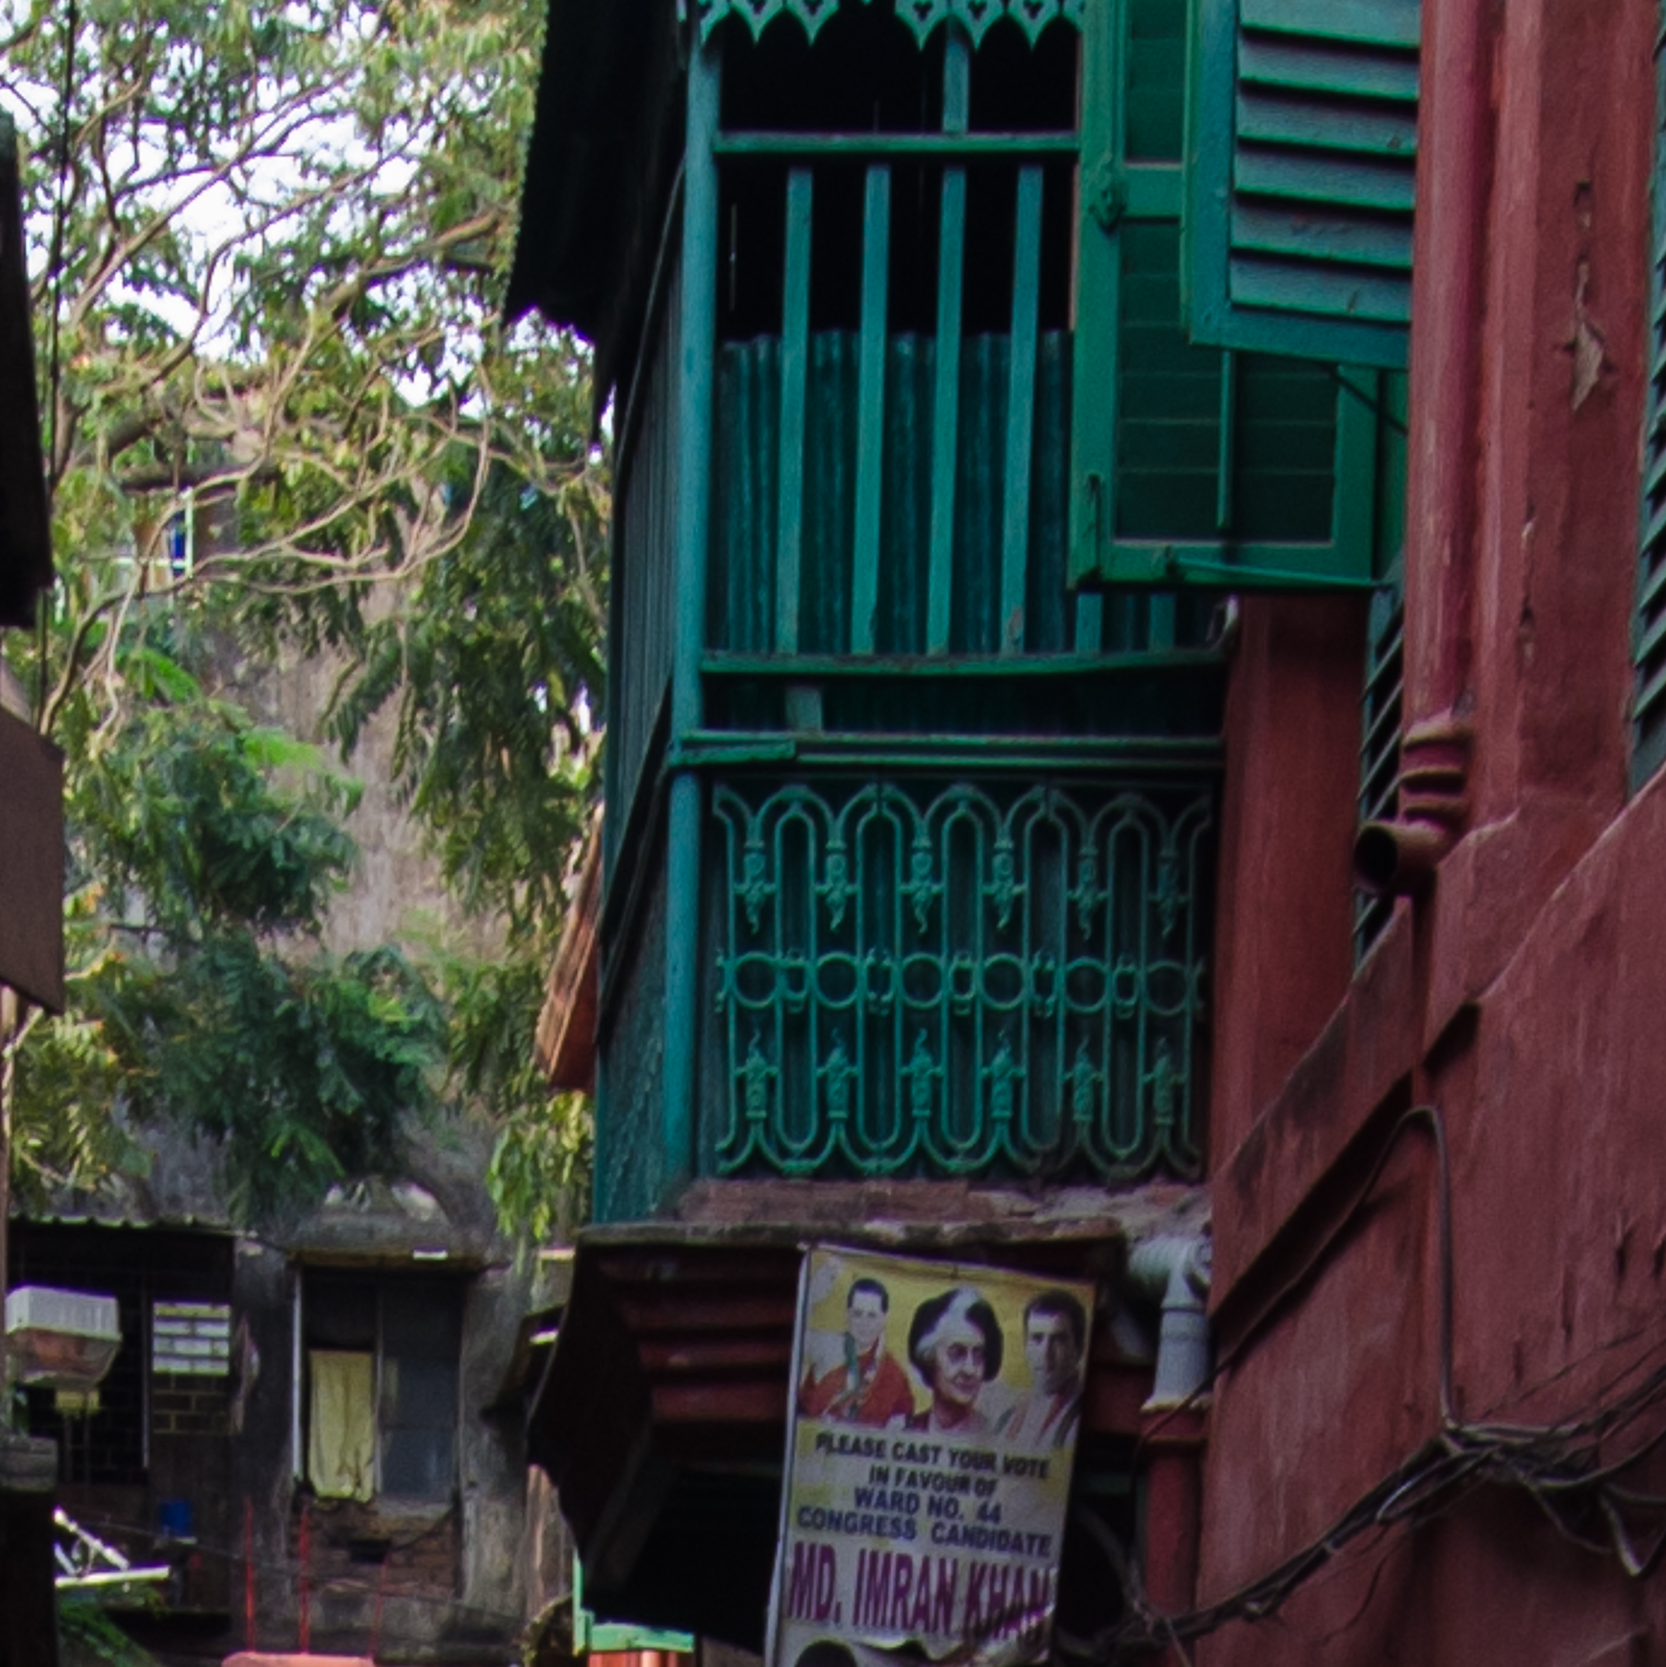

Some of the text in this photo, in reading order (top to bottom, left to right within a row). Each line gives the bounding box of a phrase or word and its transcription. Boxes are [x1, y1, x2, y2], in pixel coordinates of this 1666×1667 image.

[815, 1432, 1050, 1480] PLEASE CAST YOUR VOTE
[868, 1465, 999, 1497] IN FAVOUR OF
[854, 1487, 1001, 1524] WARD NO. 44
[796, 1505, 1053, 1559] CONGRESS CANDIDATE
[788, 1541, 1051, 1642] MD. IMRAN KHAN
